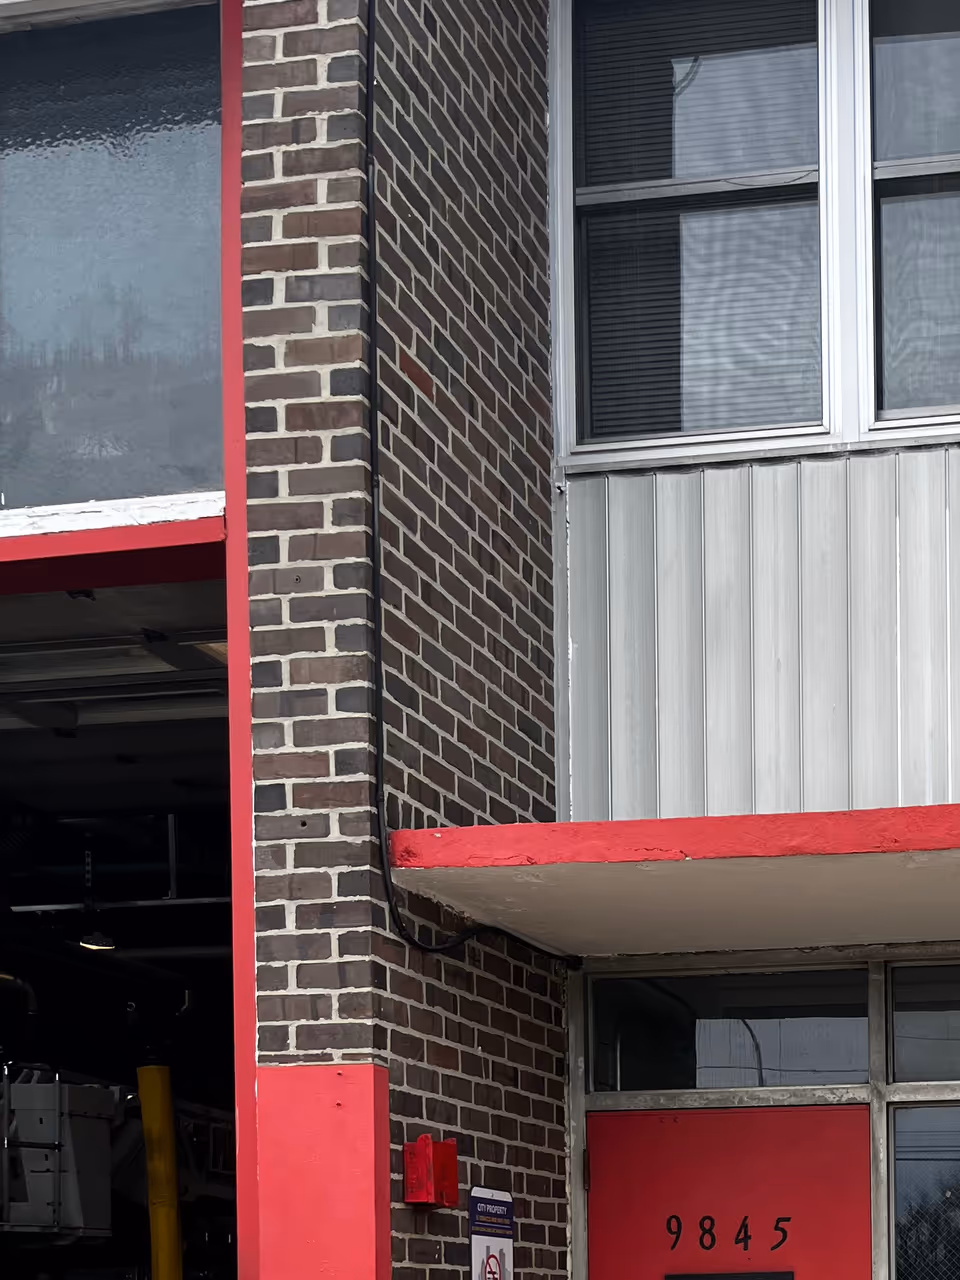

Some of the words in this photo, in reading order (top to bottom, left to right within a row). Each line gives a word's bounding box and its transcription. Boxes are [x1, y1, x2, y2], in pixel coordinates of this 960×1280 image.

[477, 1202, 486, 1212] CITY
[486, 1204, 507, 1215] PROPERTY
[666, 1214, 792, 1251] 9845
